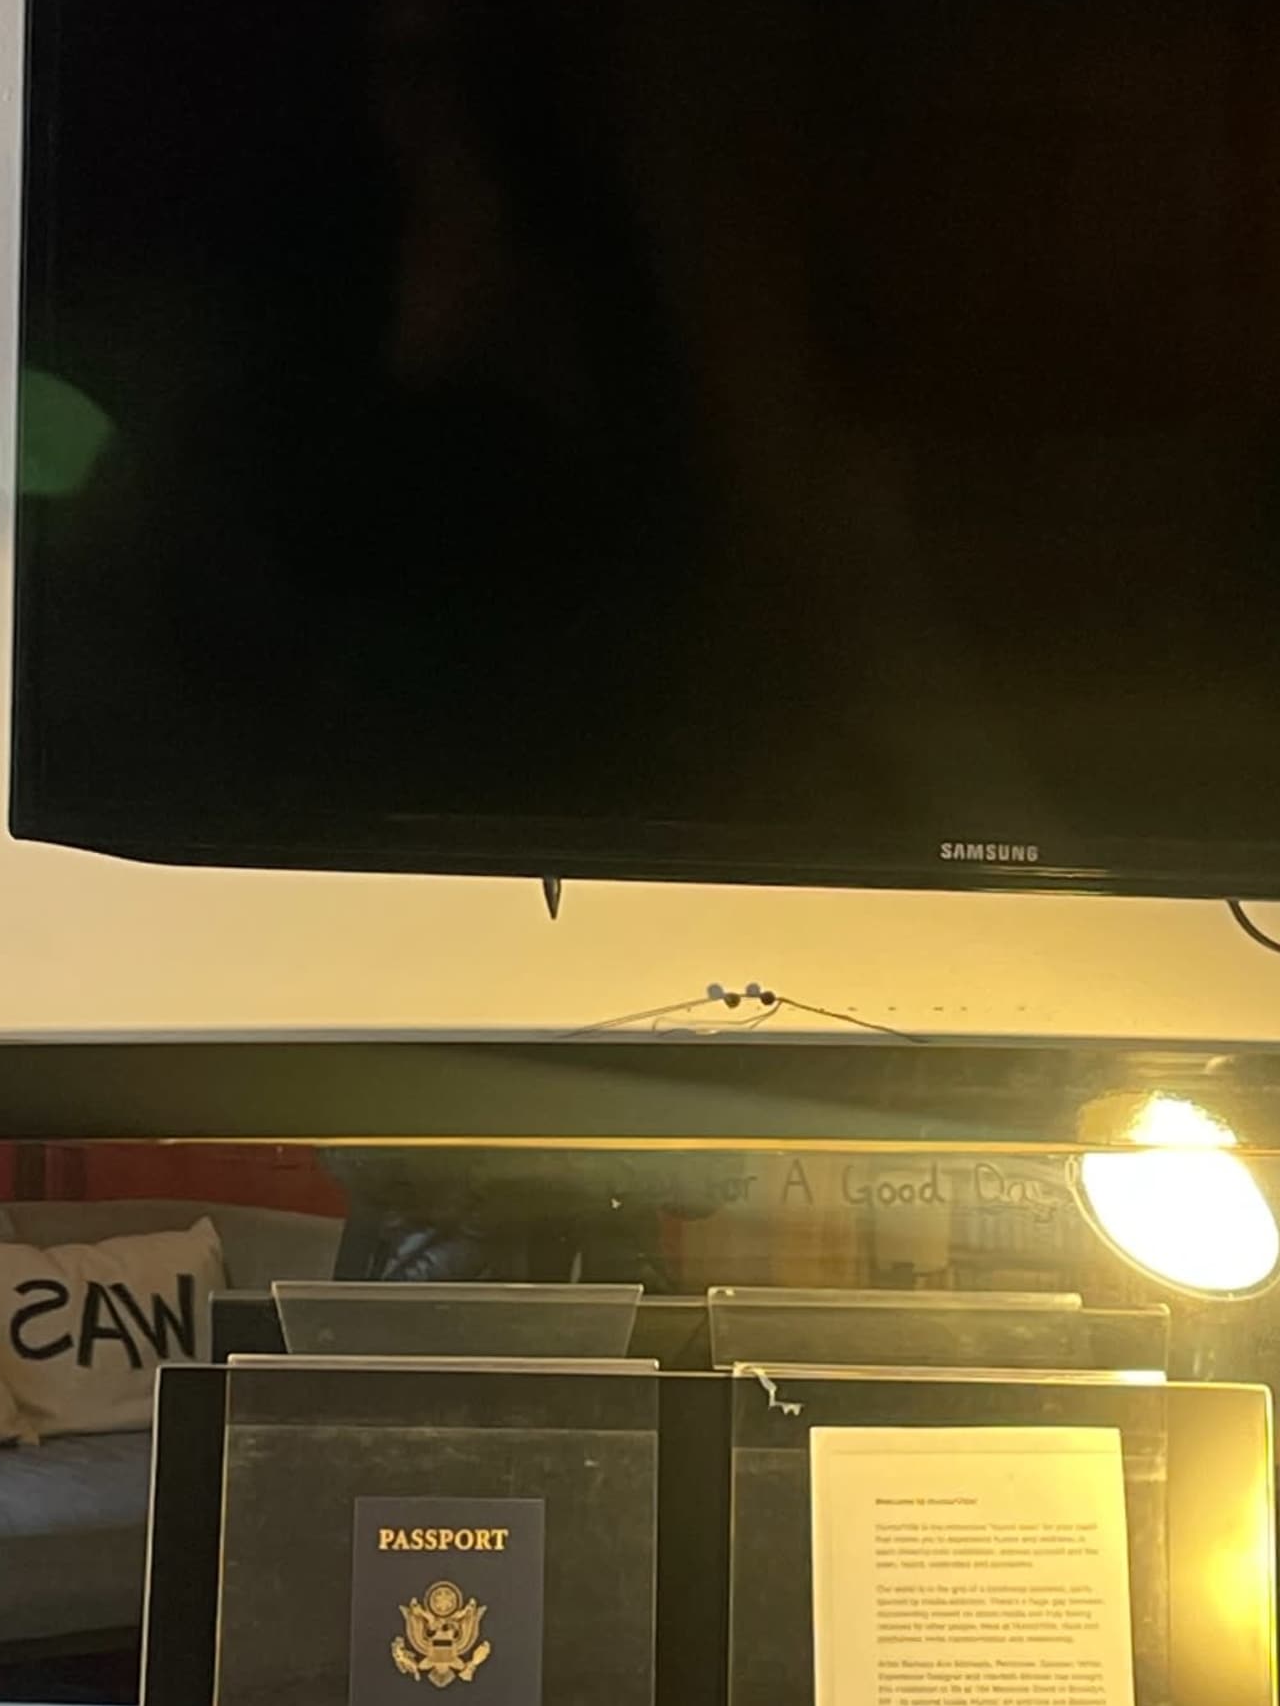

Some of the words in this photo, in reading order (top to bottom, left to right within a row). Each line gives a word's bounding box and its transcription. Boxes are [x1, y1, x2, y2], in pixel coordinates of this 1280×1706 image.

[941, 843, 1038, 861] SAMSUNG
[841, 1162, 945, 1208] Good
[378, 1528, 509, 1550] PASSPORT
